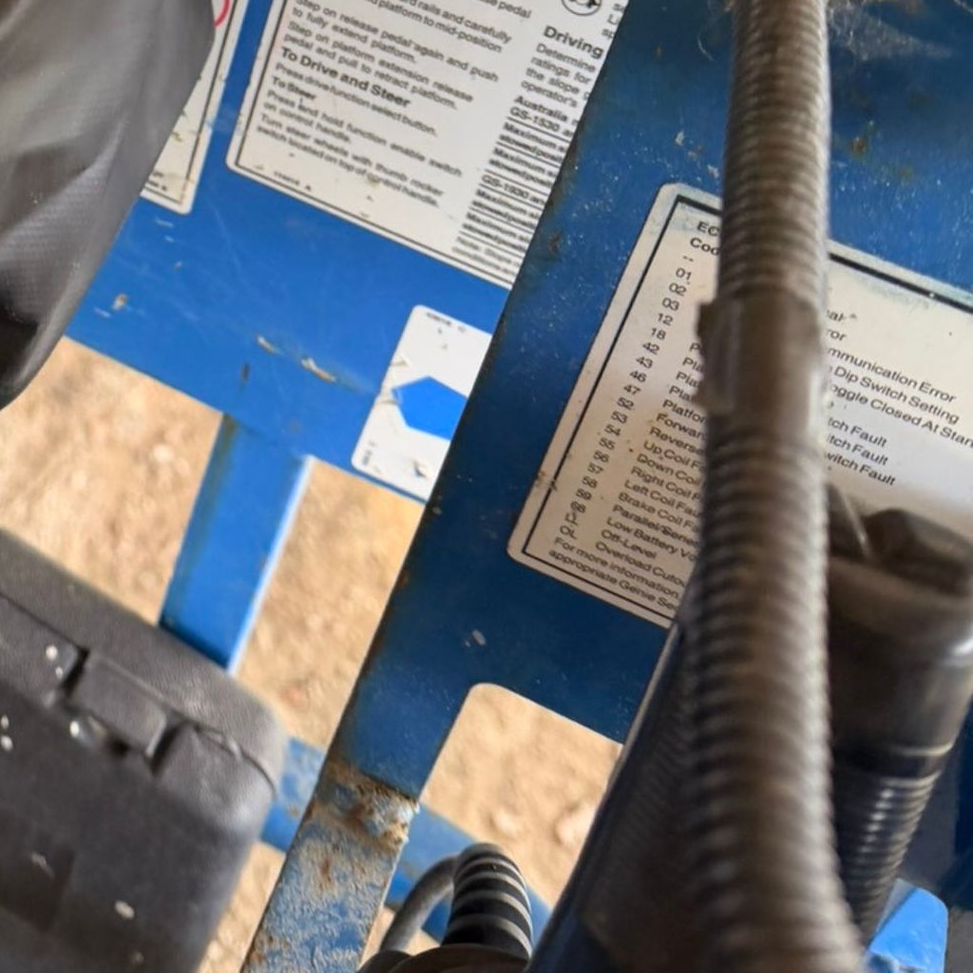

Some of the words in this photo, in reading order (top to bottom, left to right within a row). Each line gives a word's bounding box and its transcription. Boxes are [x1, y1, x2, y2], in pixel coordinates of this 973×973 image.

[543, 25, 604, 59] Driving
[282, 46, 298, 61] To
[299, 54, 338, 78] Drive
[339, 73, 369, 91] and
[370, 84, 410, 107] Steer
[668, 282, 686, 296] 02
[675, 267, 691, 280] 01
[657, 312, 673, 326] 12
[661, 297, 679, 311] 03
[642, 342, 659, 355] 42
[651, 327, 666, 340] 18
[629, 370, 646, 382] 46
[635, 356, 653, 368] 43
[826, 347, 917, 388] mmunication
[918, 381, 955, 402] Error
[623, 384, 641, 395] 47
[662, 399, 707, 423] Platfor
[833, 365, 858, 383] Dip
[859, 376, 907, 402] Switch
[907, 396, 959, 425] Setting
[610, 410, 627, 424] 53
[617, 397, 634, 410] 52
[655, 412, 705, 438] Forwar
[869, 398, 922, 426] Closed
[921, 420, 939, 433] At
[939, 426, 973, 445] Star
[604, 424, 621, 436] 54
[642, 440, 662, 454] Up
[663, 449, 690, 466] Coil
[849, 425, 887, 447] Fault
[598, 438, 614, 450] 55
[636, 453, 674, 475] Down
[824, 452, 858, 471] witch
[858, 464, 895, 486] Fault
[851, 443, 888, 465] Fault
[587, 462, 603, 474] 57
[623, 479, 649, 496] Left
[649, 490, 675, 507] Coil
[593, 451, 609, 462] 56
[630, 465, 664, 487] Right
[664, 481, 692, 498] Coil
